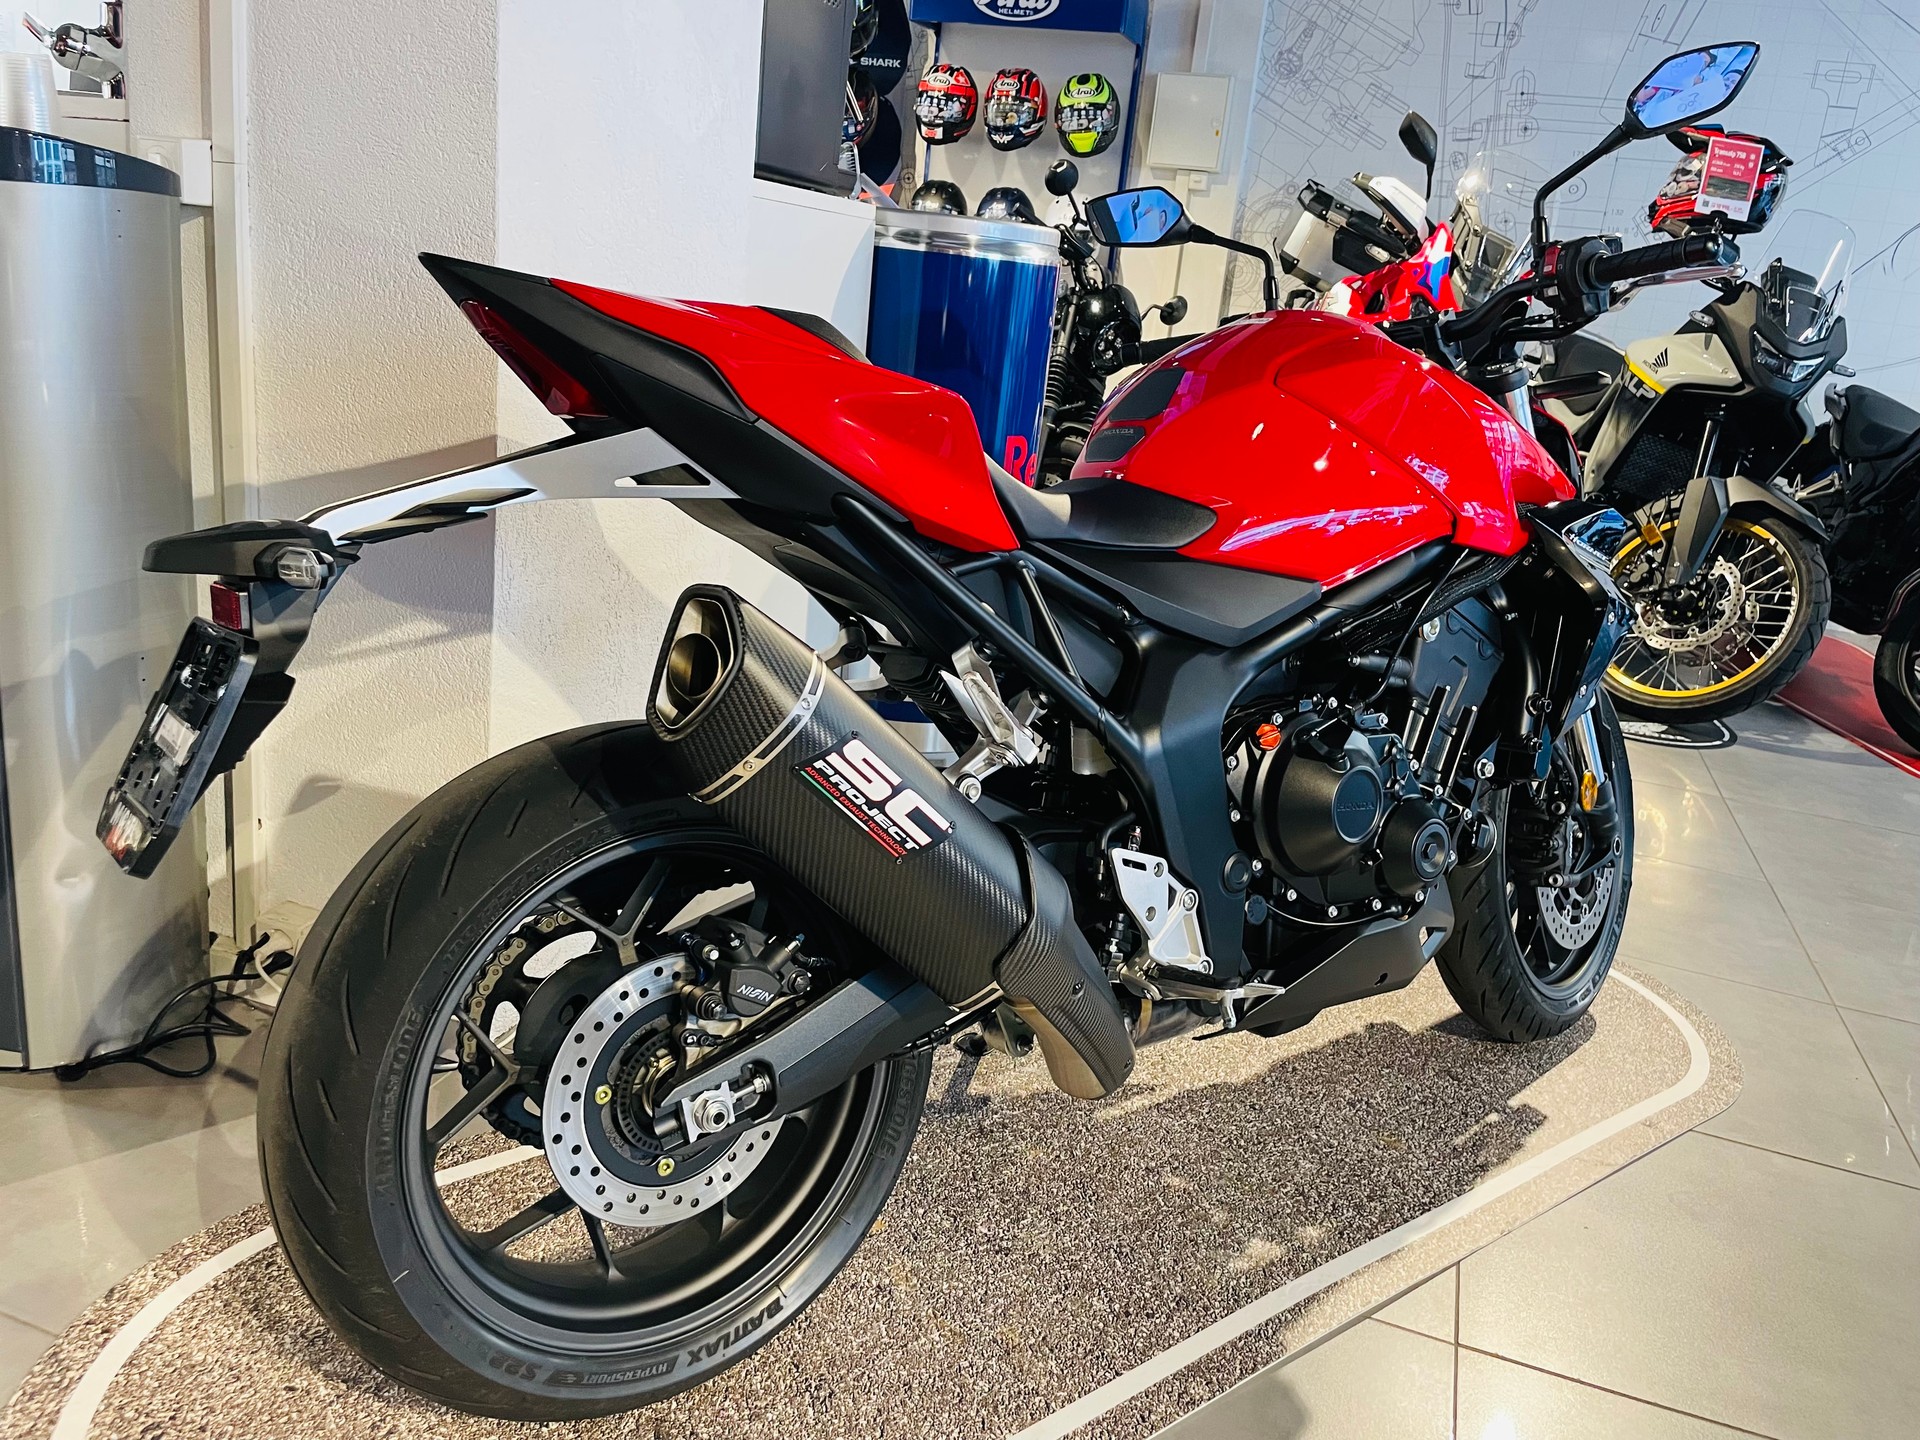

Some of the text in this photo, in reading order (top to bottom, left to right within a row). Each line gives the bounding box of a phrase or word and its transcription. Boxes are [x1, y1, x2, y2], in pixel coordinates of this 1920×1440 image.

[860, 56, 901, 68] SHARK
[933, 76, 947, 84] Arai
[1076, 88, 1093, 96] Arai
[812, 759, 920, 850] PROJECT
[825, 739, 951, 847] SC
[805, 766, 908, 856] ADVANCED EXHAUST TECHNOLOGY
[1336, 803, 1375, 812] HONDA
[687, 1296, 785, 1367] BATTLAX
[581, 1361, 669, 1385] HYPERSPORT
